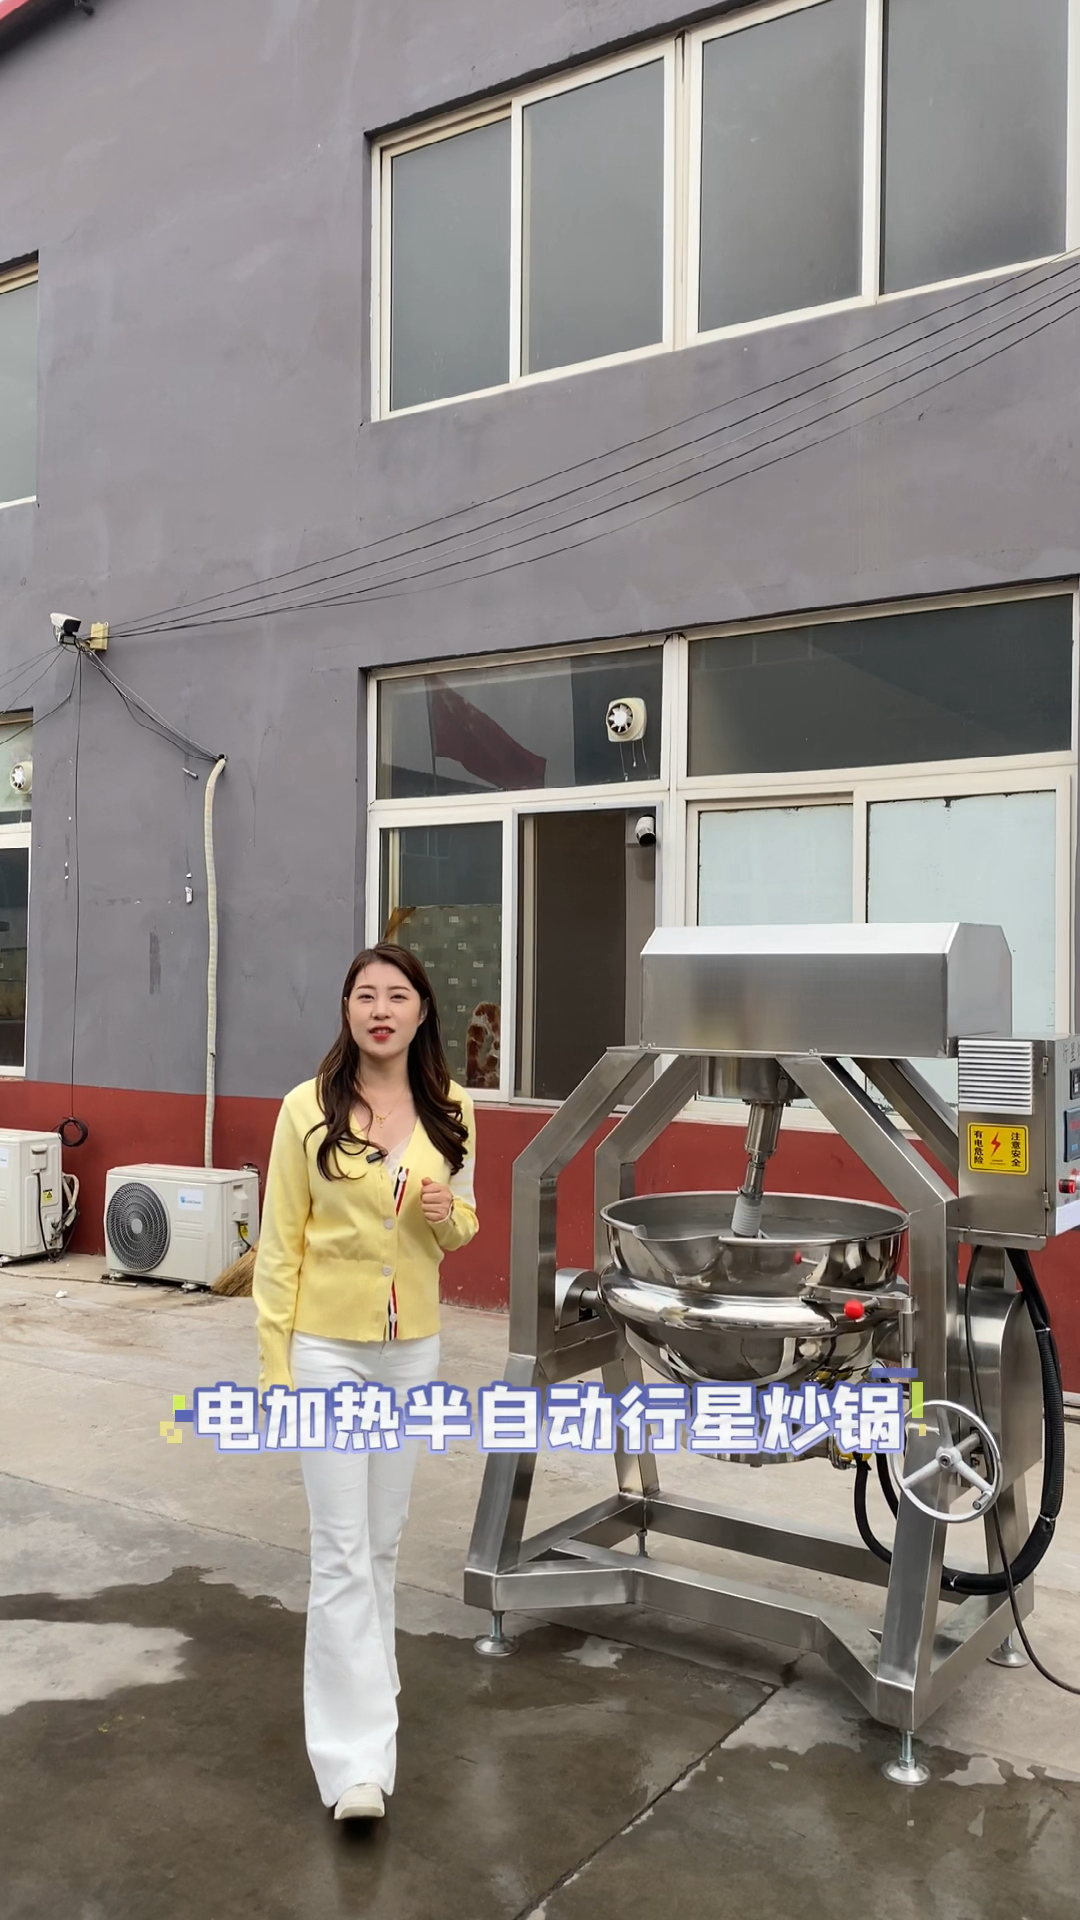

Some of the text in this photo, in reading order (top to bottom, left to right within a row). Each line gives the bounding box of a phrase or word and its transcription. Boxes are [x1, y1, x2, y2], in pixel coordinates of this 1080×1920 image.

[974, 1130, 983, 1164] 有电危险
[1011, 1132, 1021, 1167] 注意安全
